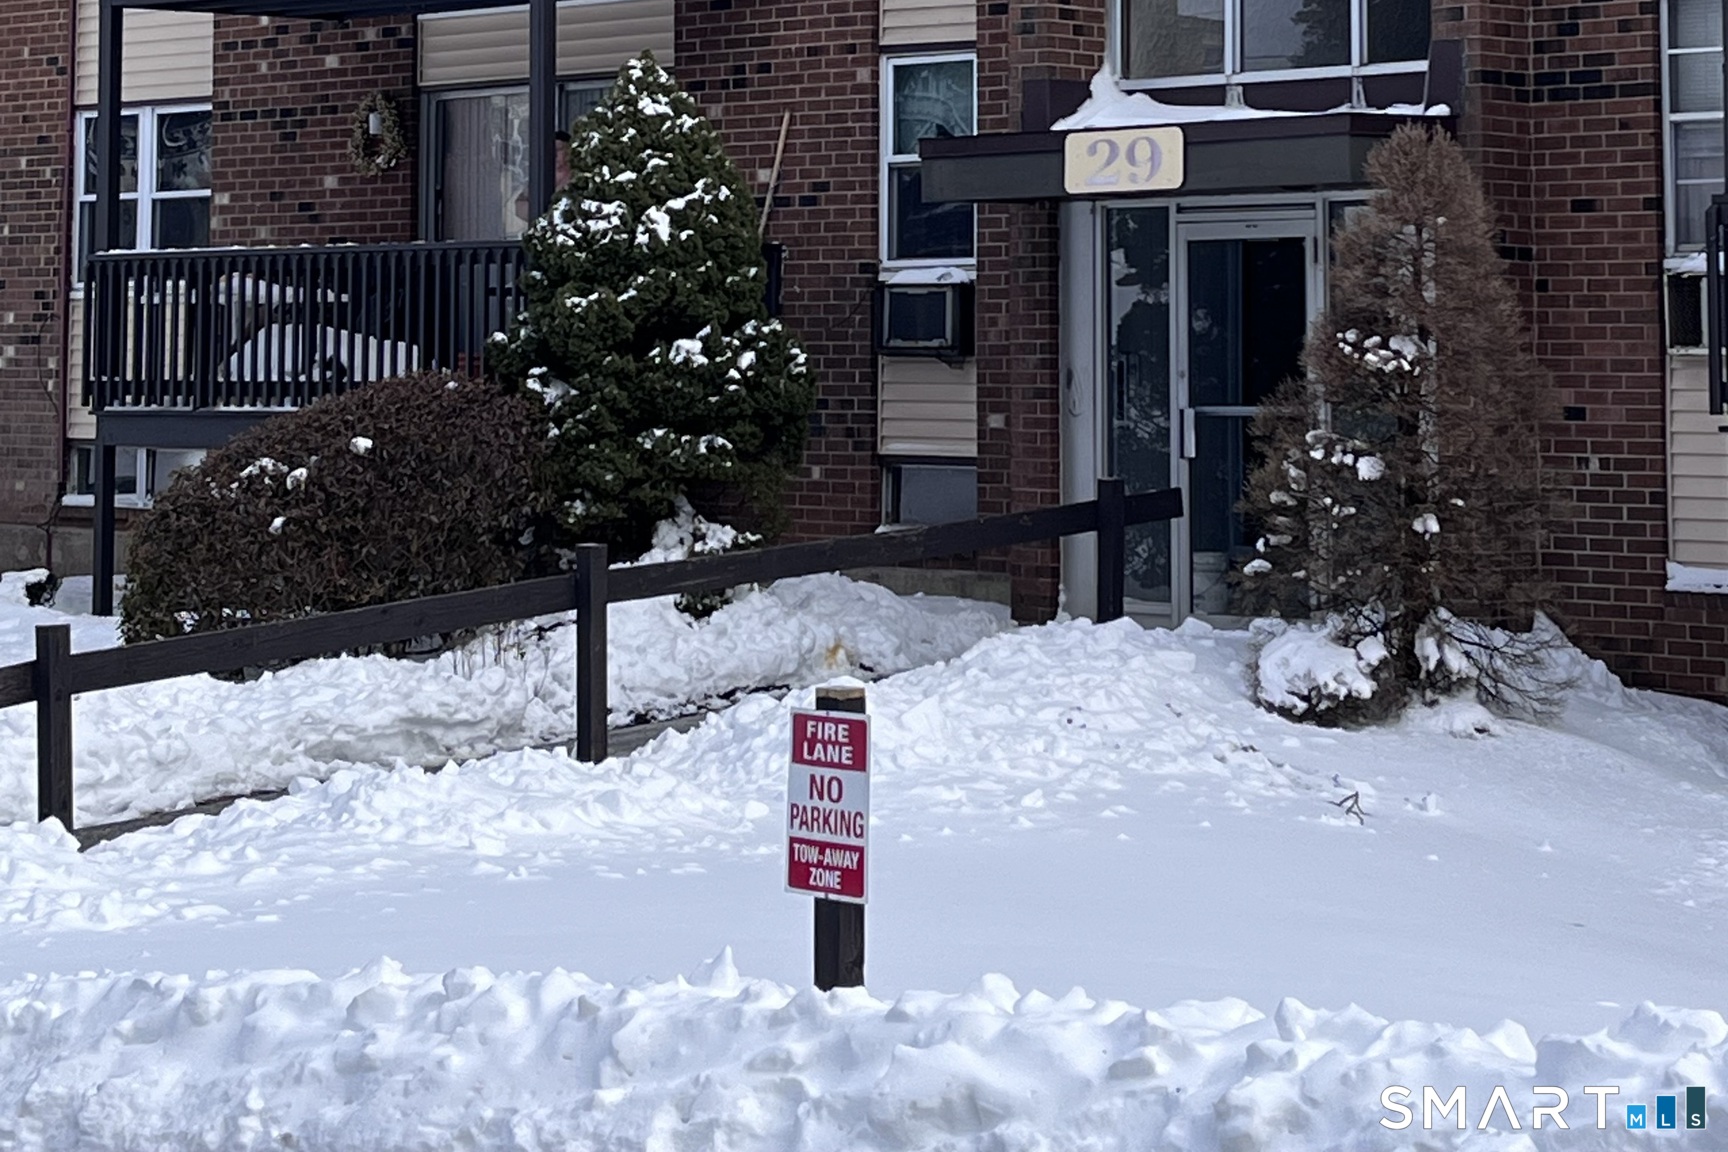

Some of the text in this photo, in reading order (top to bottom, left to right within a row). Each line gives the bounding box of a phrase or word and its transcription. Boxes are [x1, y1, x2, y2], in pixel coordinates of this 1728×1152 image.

[1085, 136, 1162, 186] 29
[806, 720, 850, 743] FIRE
[803, 740, 854, 765] LANE
[809, 773, 843, 803] NO
[790, 803, 864, 839] PARKING
[793, 843, 860, 870] TOW-AWAY
[809, 867, 842, 890] ZONE
